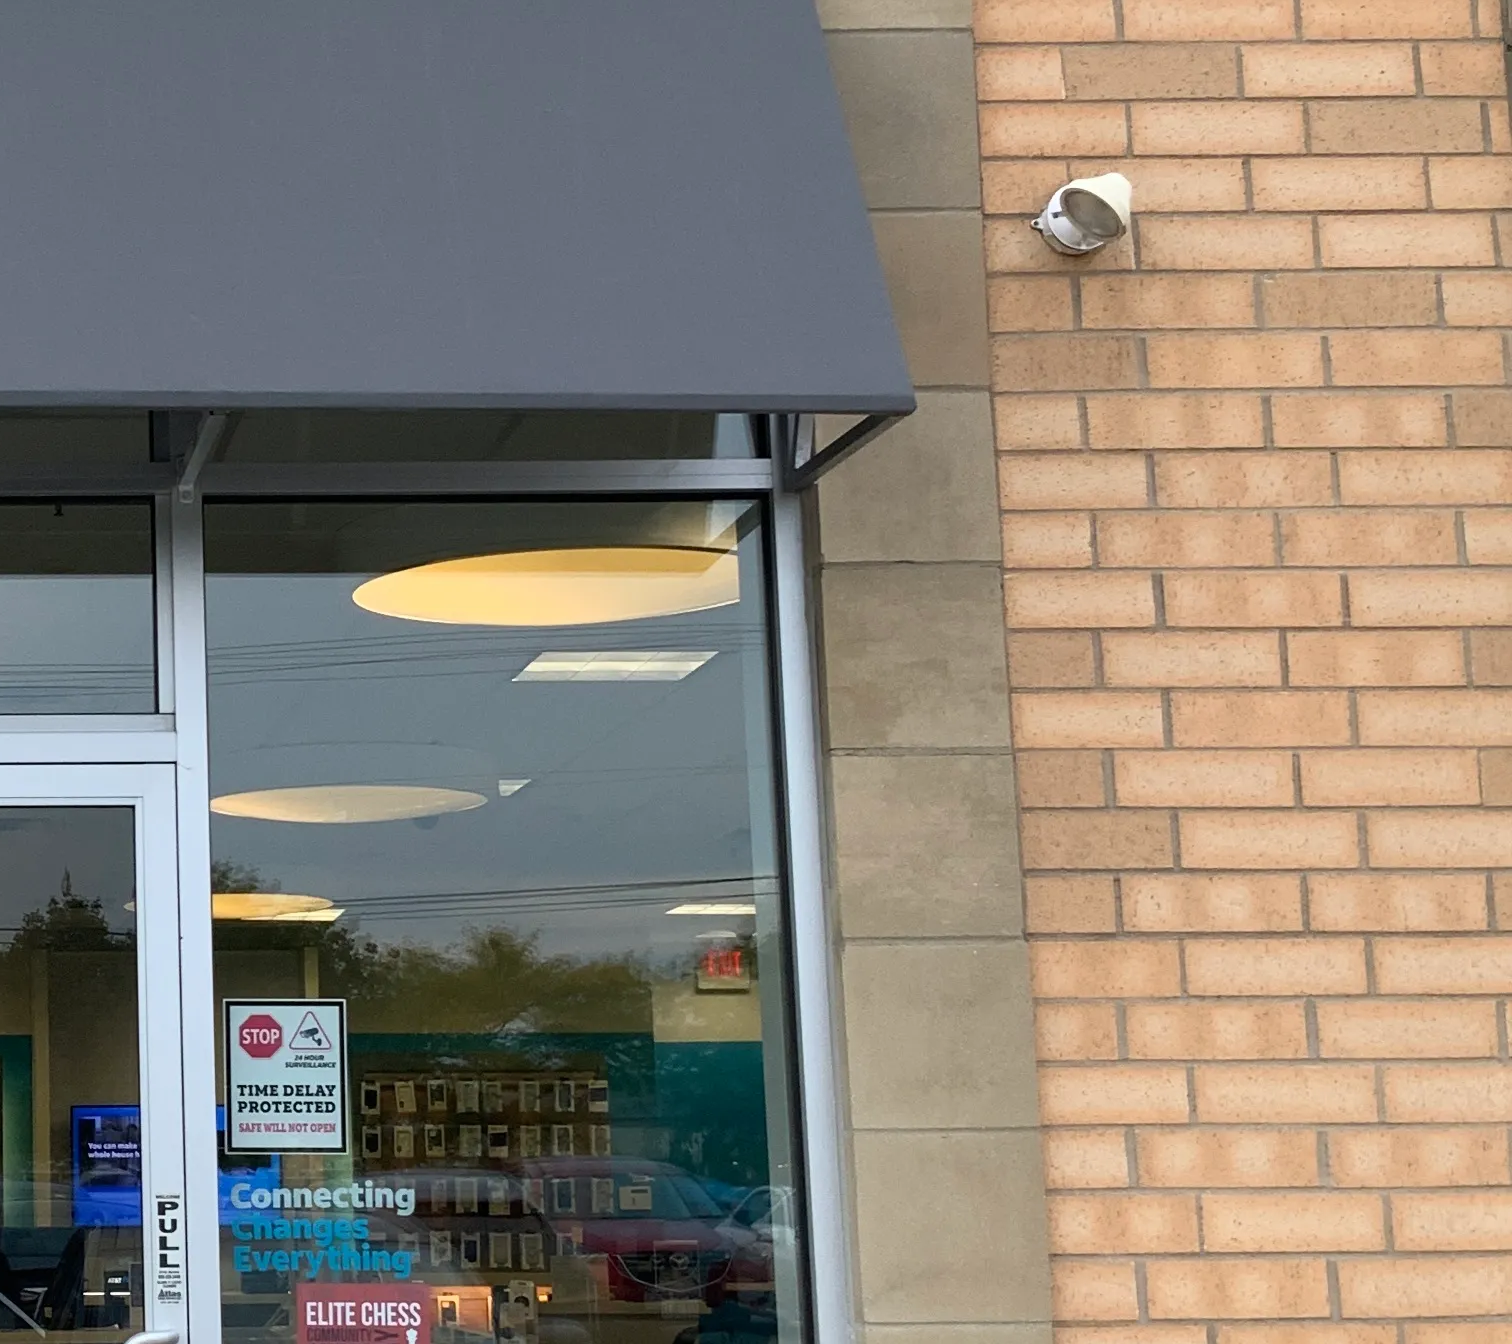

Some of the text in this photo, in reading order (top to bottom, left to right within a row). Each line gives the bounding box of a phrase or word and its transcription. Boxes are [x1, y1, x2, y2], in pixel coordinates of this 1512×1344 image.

[242, 1028, 280, 1044] STOP
[236, 1084, 336, 1097] TIME DELAY
[237, 1101, 336, 1113] PROTECTED
[238, 1123, 336, 1133] SAFE WILL NOT OPEN
[230, 1179, 416, 1216] Connecting
[157, 1200, 180, 1268] PULL
[231, 1212, 369, 1247] Changes
[232, 1242, 412, 1280] Everything
[306, 1301, 422, 1326] ELITE CHESS
[307, 1328, 372, 1342] COMMUNITY
